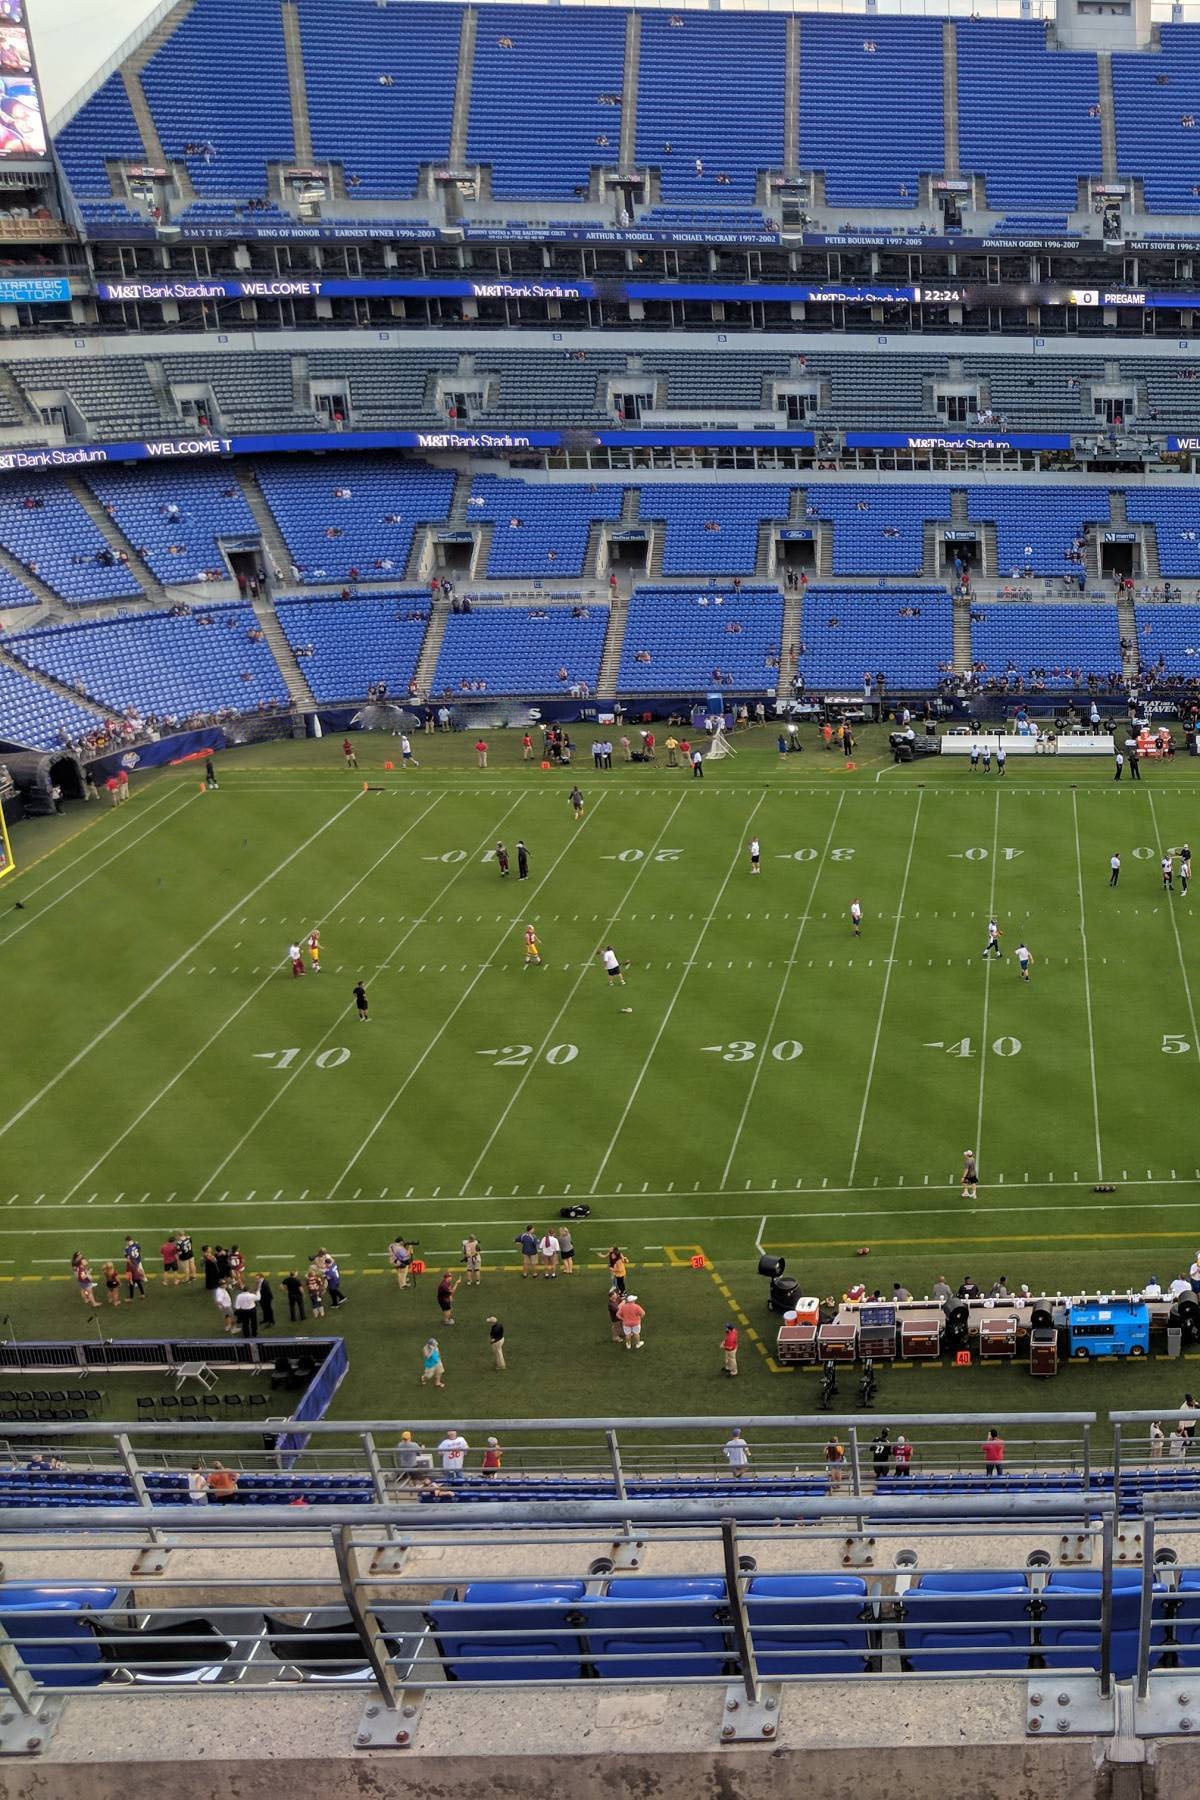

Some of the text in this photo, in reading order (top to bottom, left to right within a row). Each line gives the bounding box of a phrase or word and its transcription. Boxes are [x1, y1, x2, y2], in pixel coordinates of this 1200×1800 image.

[257, 229, 278, 237] RING
[279, 229, 289, 237] OF
[292, 229, 320, 237] HONOR
[335, 229, 436, 238] EARNEST BYNER 1996-2003
[586, 232, 654, 240] ARTHUR B. MODELL
[705, 234, 736, 242] McCRARY
[739, 234, 776, 242] 1997-2002
[825, 236, 922, 245] PETER BOULWARE 1997-2005
[981, 240, 1080, 249] JONATHAN OGDEN 1996-2007
[1131, 242, 1149, 250] MATT
[1150, 242, 1175, 250] STOVER
[0, 280, 63, 290] TRATEGIC
[241, 283, 322, 295] WELCOME T
[473, 284, 579, 297] M&T Bank Stadium
[107, 284, 225, 298] M&T Bank Stadium
[924, 290, 960, 301] 22:24
[1083, 293, 1092, 304] 0
[1104, 294, 1146, 304] PREGAME
[418, 434, 530, 447] M&T Bank Stadium
[146, 439, 233, 456] WELCOME T
[17, 452, 51, 468] Bank
[52, 449, 107, 465] Stadium
[722, 1041, 804, 1061] 30
[946, 1036, 1022, 1058] 40
[272, 1047, 351, 1069] 10
[494, 1044, 579, 1065] 20
[411, 1262, 422, 1272] 20
[958, 1352, 969, 1364] 40
[875, 1445, 885, 1454] 27
